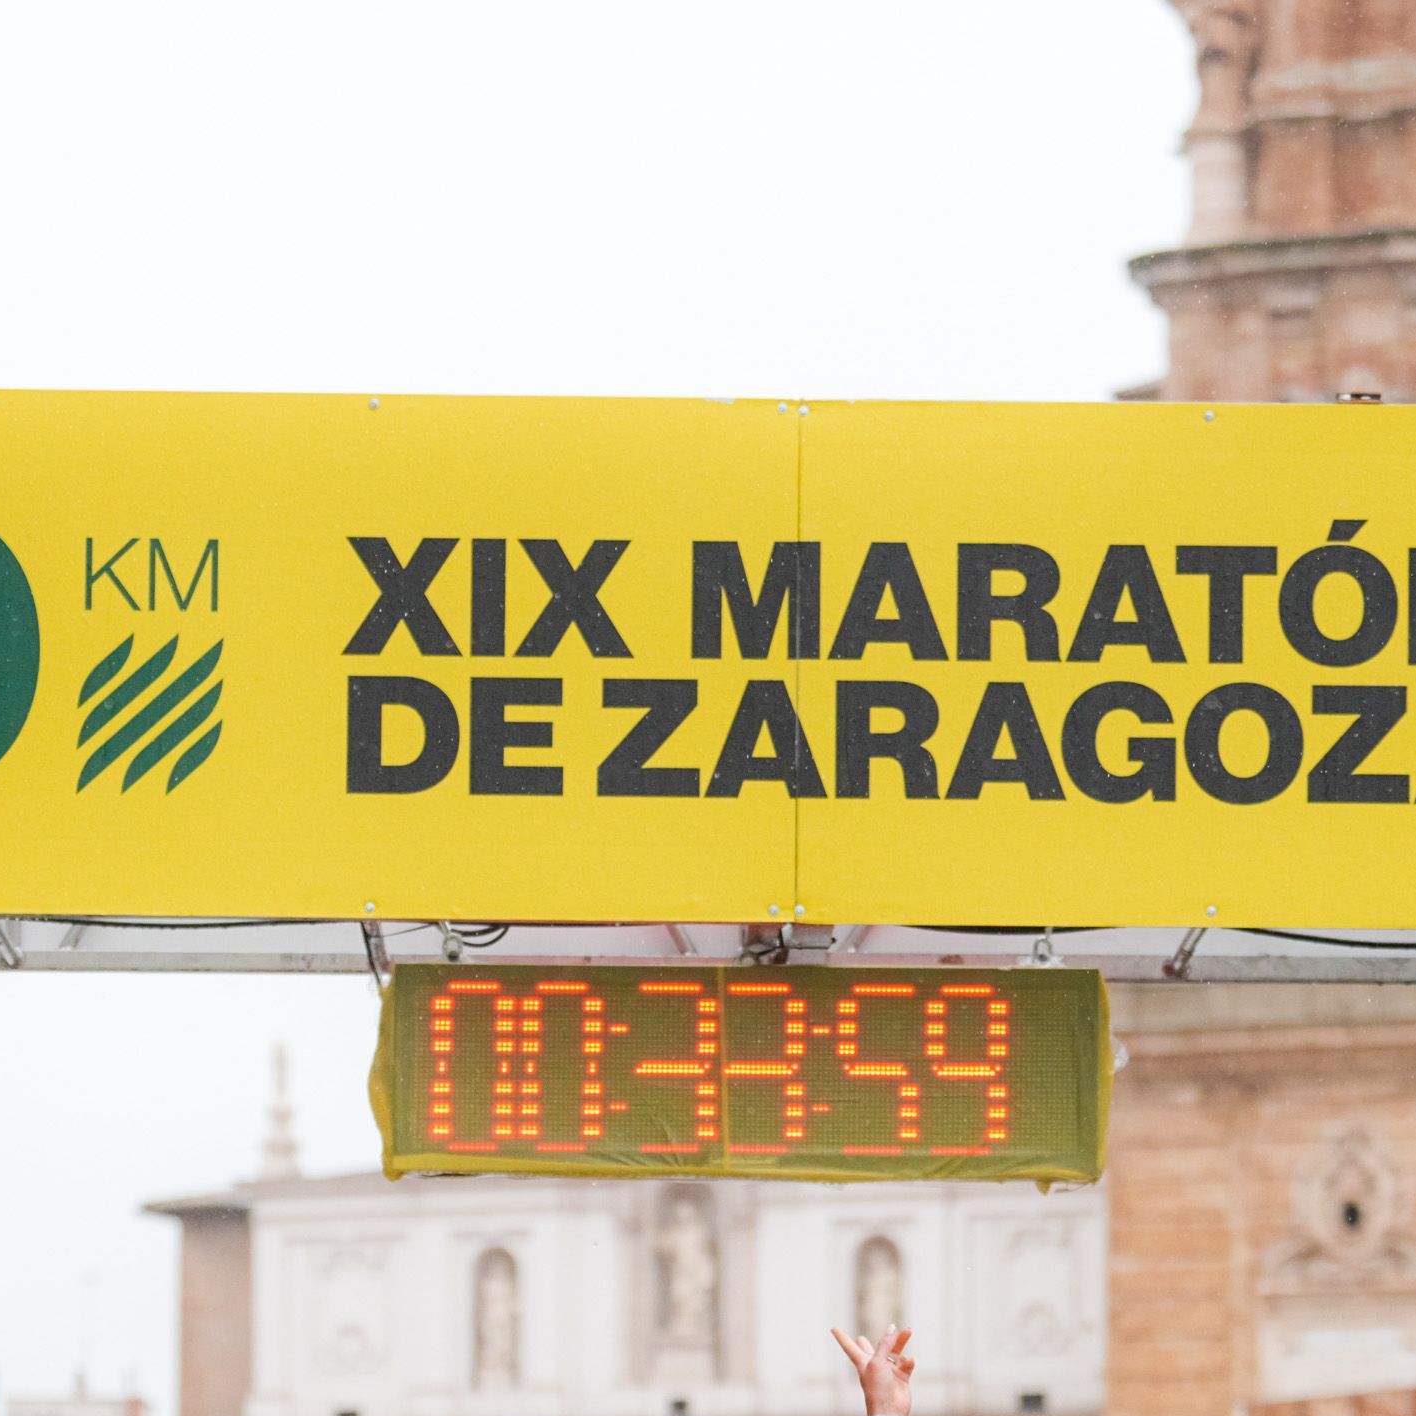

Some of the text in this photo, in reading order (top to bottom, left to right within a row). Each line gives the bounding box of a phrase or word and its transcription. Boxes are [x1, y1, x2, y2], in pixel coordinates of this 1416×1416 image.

[83, 536, 220, 613] KM
[340, 535, 634, 659] XIX
[346, 675, 565, 796] DE
[431, 981, 1010, 1156] 00:33:59
